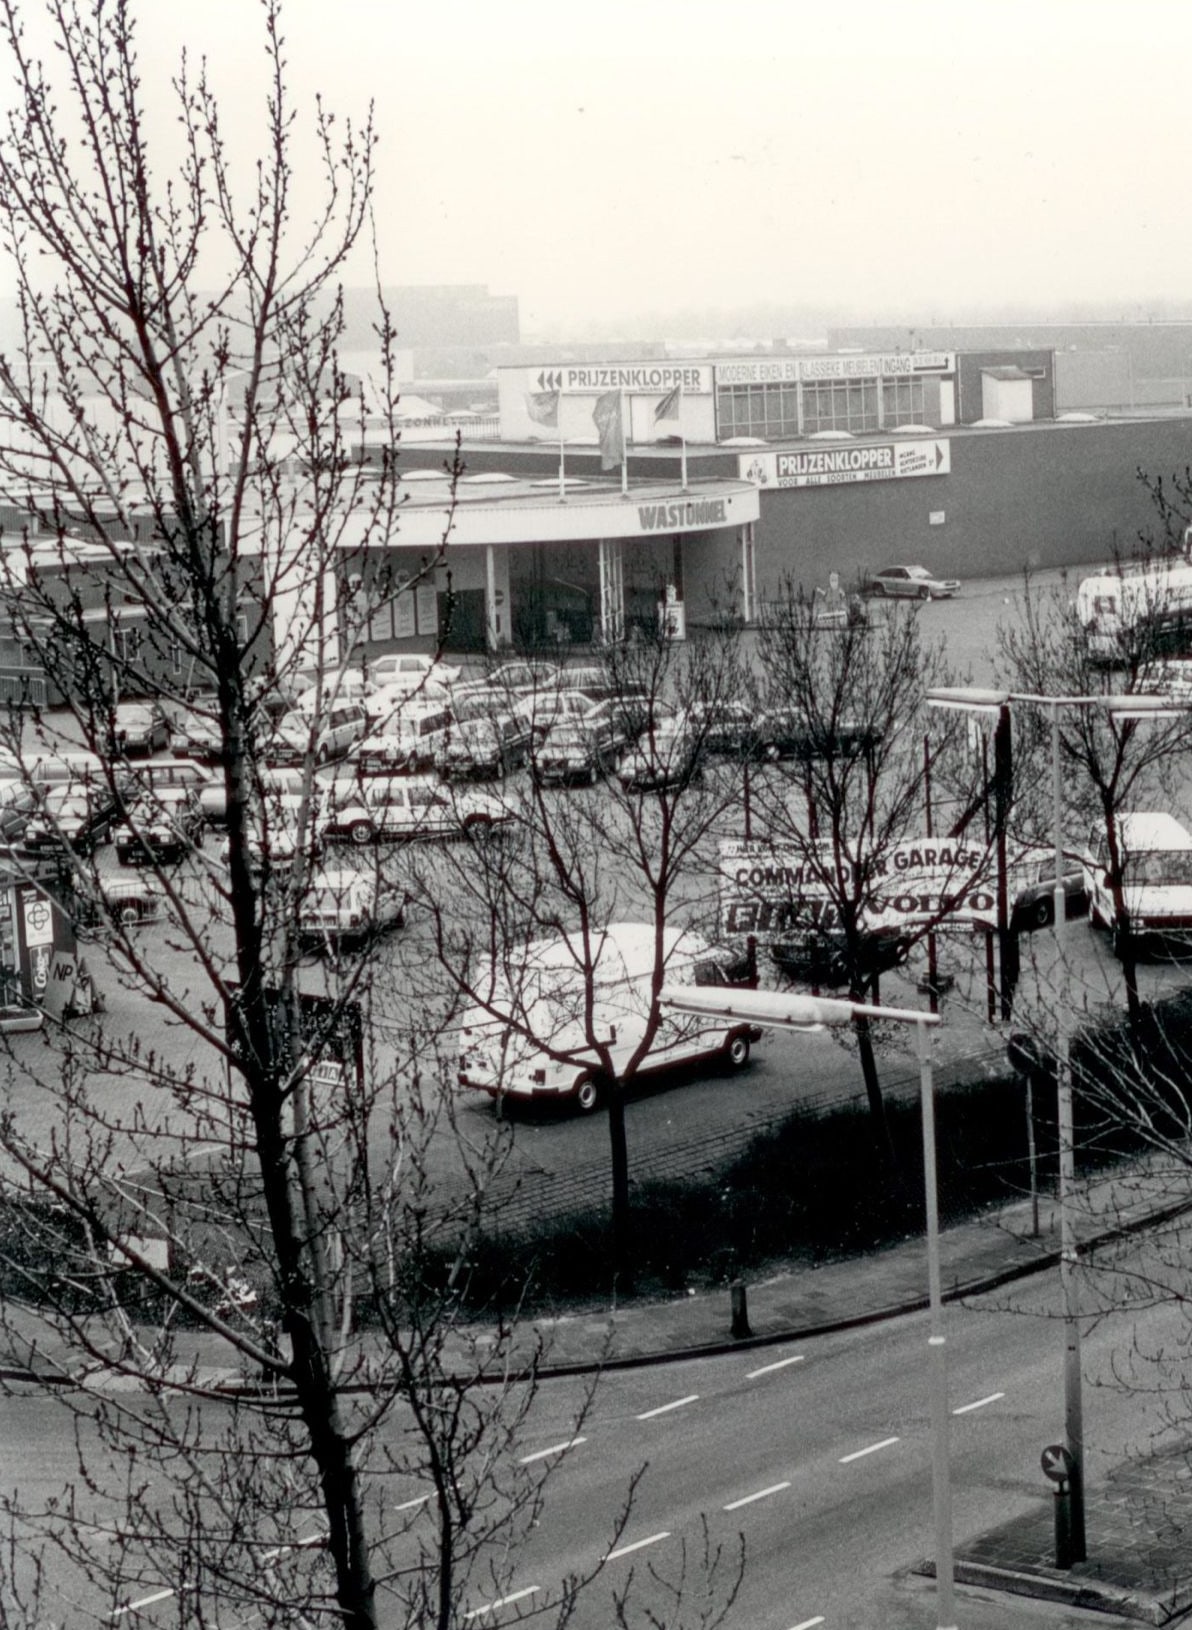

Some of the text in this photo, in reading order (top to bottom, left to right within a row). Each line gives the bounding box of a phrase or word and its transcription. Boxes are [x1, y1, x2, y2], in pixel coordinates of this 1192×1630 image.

[568, 368, 701, 387] PRIJZENKLOPPER
[718, 364, 757, 382] MODERNE
[759, 363, 783, 381] EIKEN
[785, 361, 796, 380] EN
[779, 448, 892, 475] PRIJZENKLOPPER
[778, 477, 798, 488] VOOR
[806, 475, 821, 486] ALLE
[736, 848, 981, 887] COMMANDR GARAGE
[867, 893, 995, 914] VOLVO
